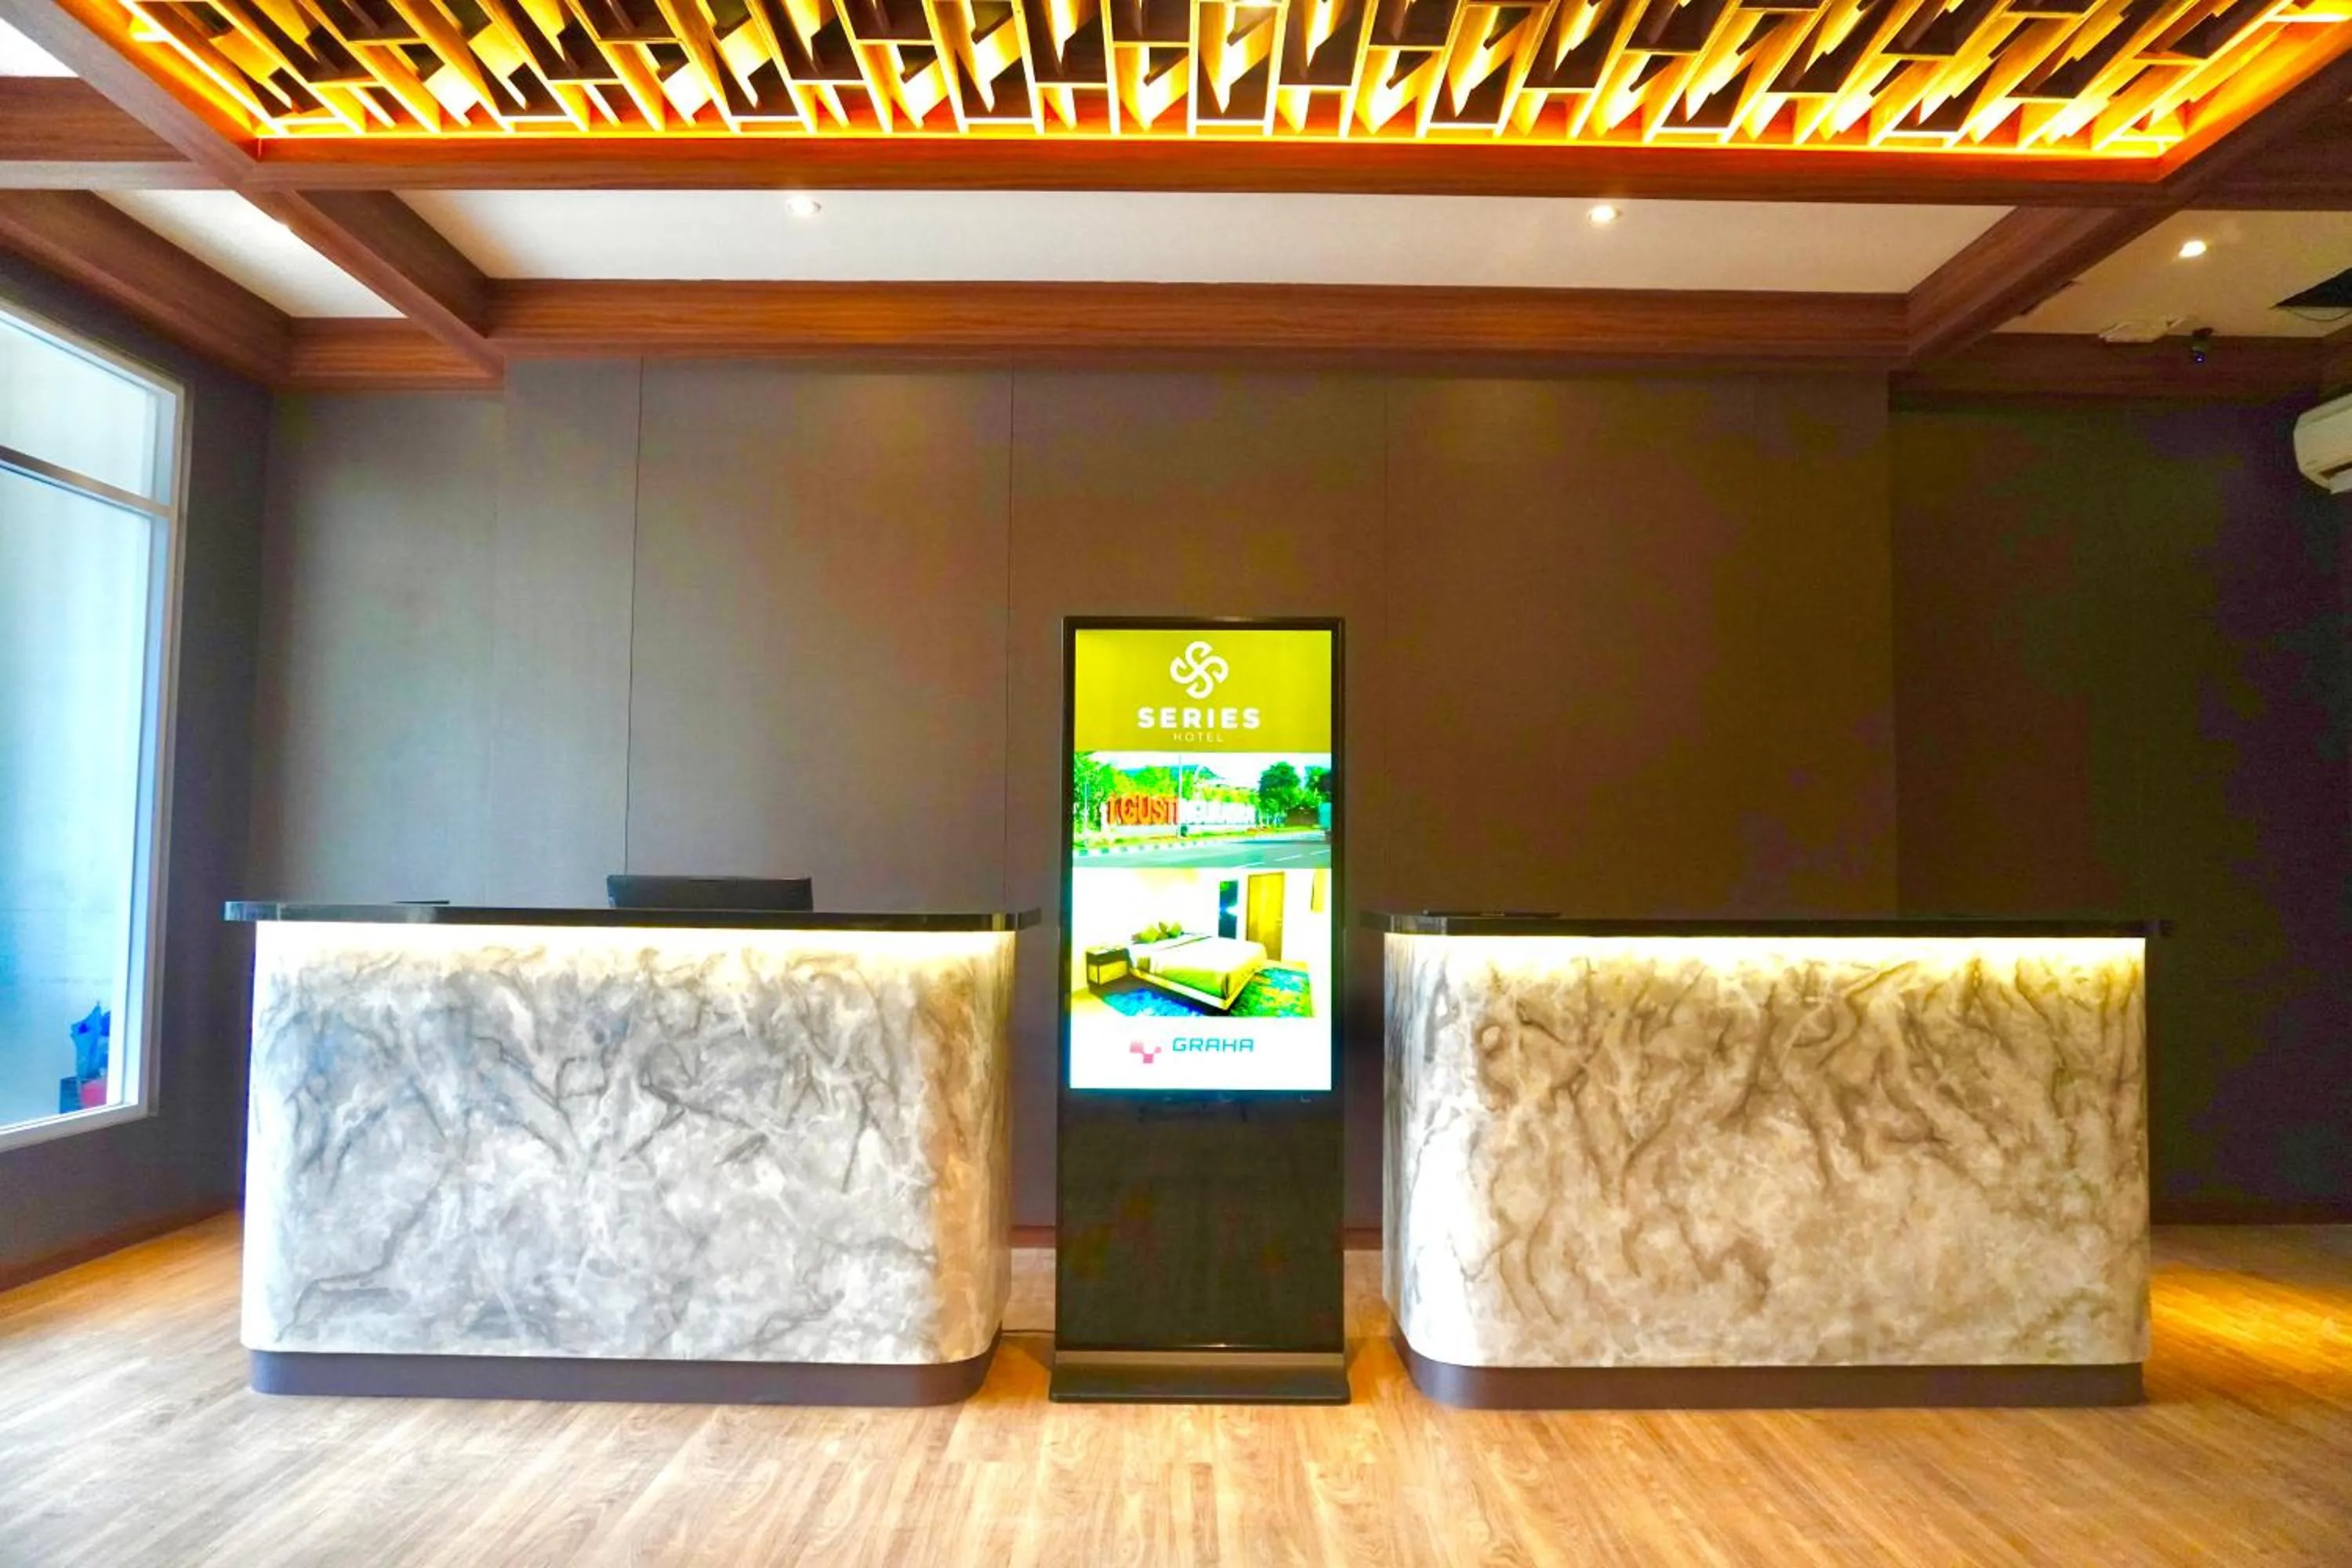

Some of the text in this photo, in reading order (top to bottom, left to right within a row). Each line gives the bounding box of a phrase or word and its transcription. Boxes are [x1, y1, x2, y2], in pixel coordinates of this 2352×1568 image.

[1138, 707, 1261, 728] SERIES
[1173, 731, 1224, 742] HOTEL
[1172, 1037, 1254, 1052] GRAHA
